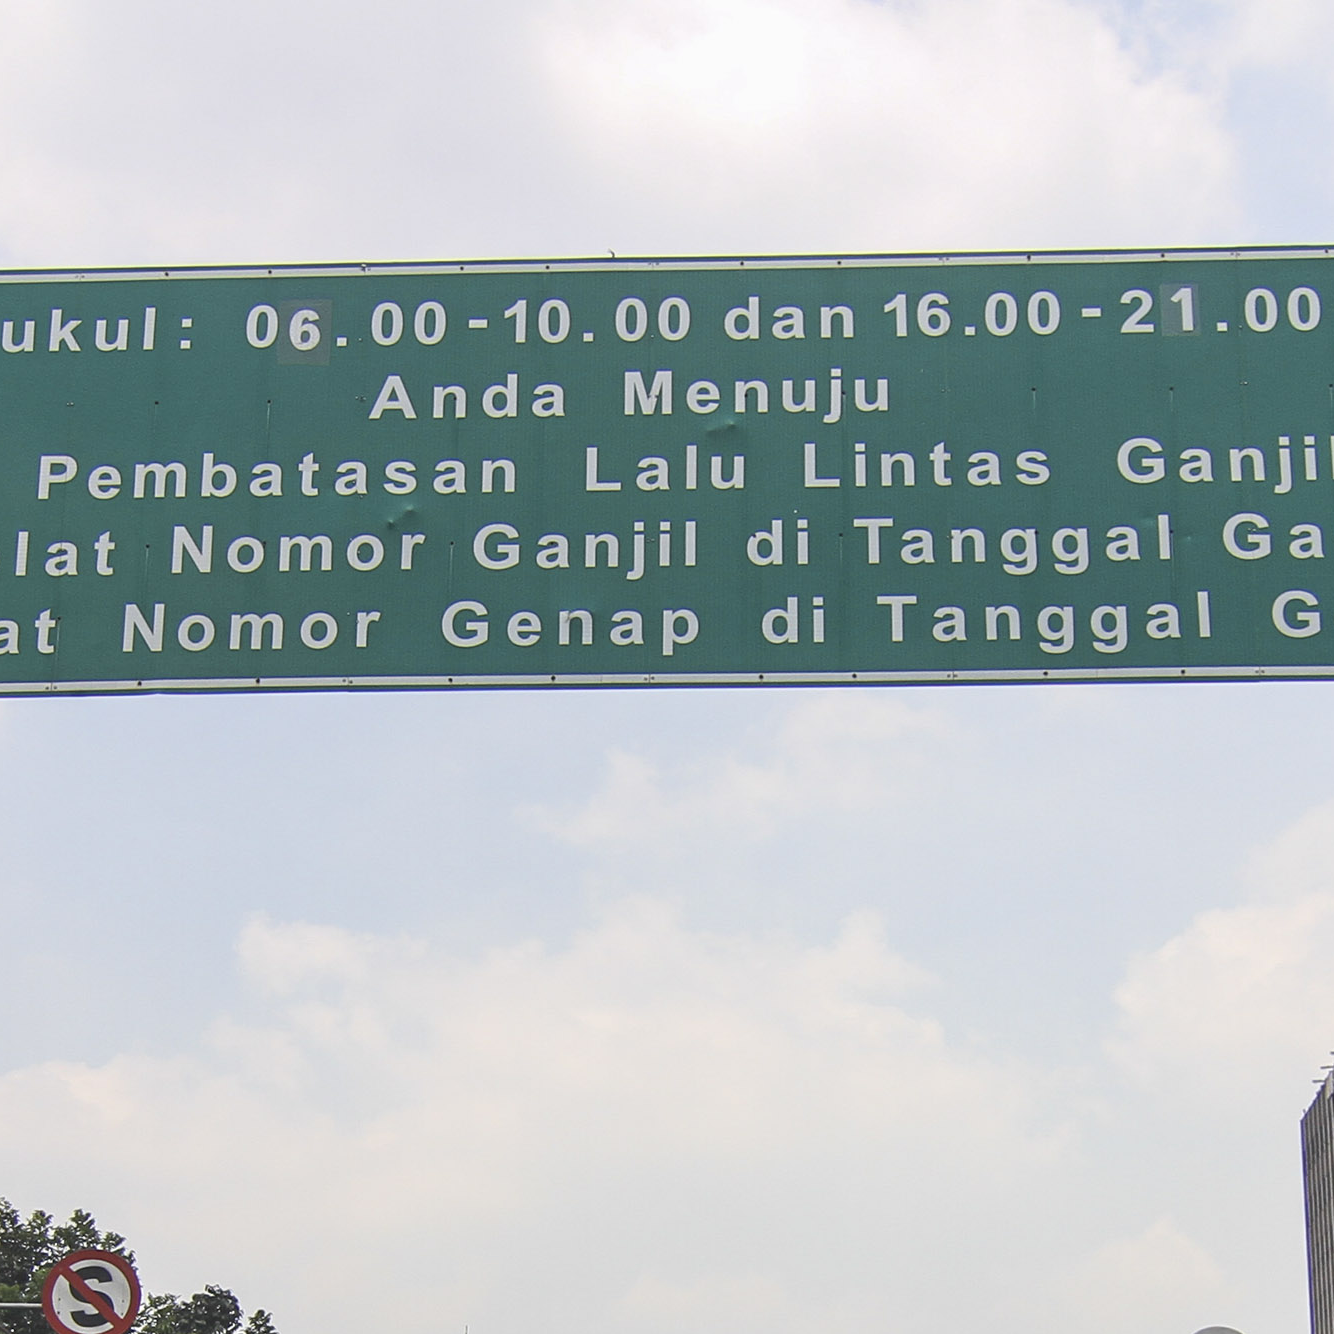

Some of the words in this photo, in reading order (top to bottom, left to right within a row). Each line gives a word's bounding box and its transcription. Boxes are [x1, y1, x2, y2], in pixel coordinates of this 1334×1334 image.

[724, 296, 854, 340] dan
[368, 373, 565, 419] Anda
[624, 368, 889, 424] Menuju
[37, 452, 516, 500] Pembatasan
[585, 445, 745, 491] Lalu
[804, 442, 1050, 488] Lintas
[171, 525, 426, 574] Nomor
[473, 520, 696, 580] Ganjil
[746, 519, 809, 566] di
[853, 514, 1171, 576] Tanggal
[122, 603, 381, 652] Nomor
[441, 600, 699, 656] Genap
[761, 596, 825, 644] di
[876, 591, 1211, 654] Tanggal
